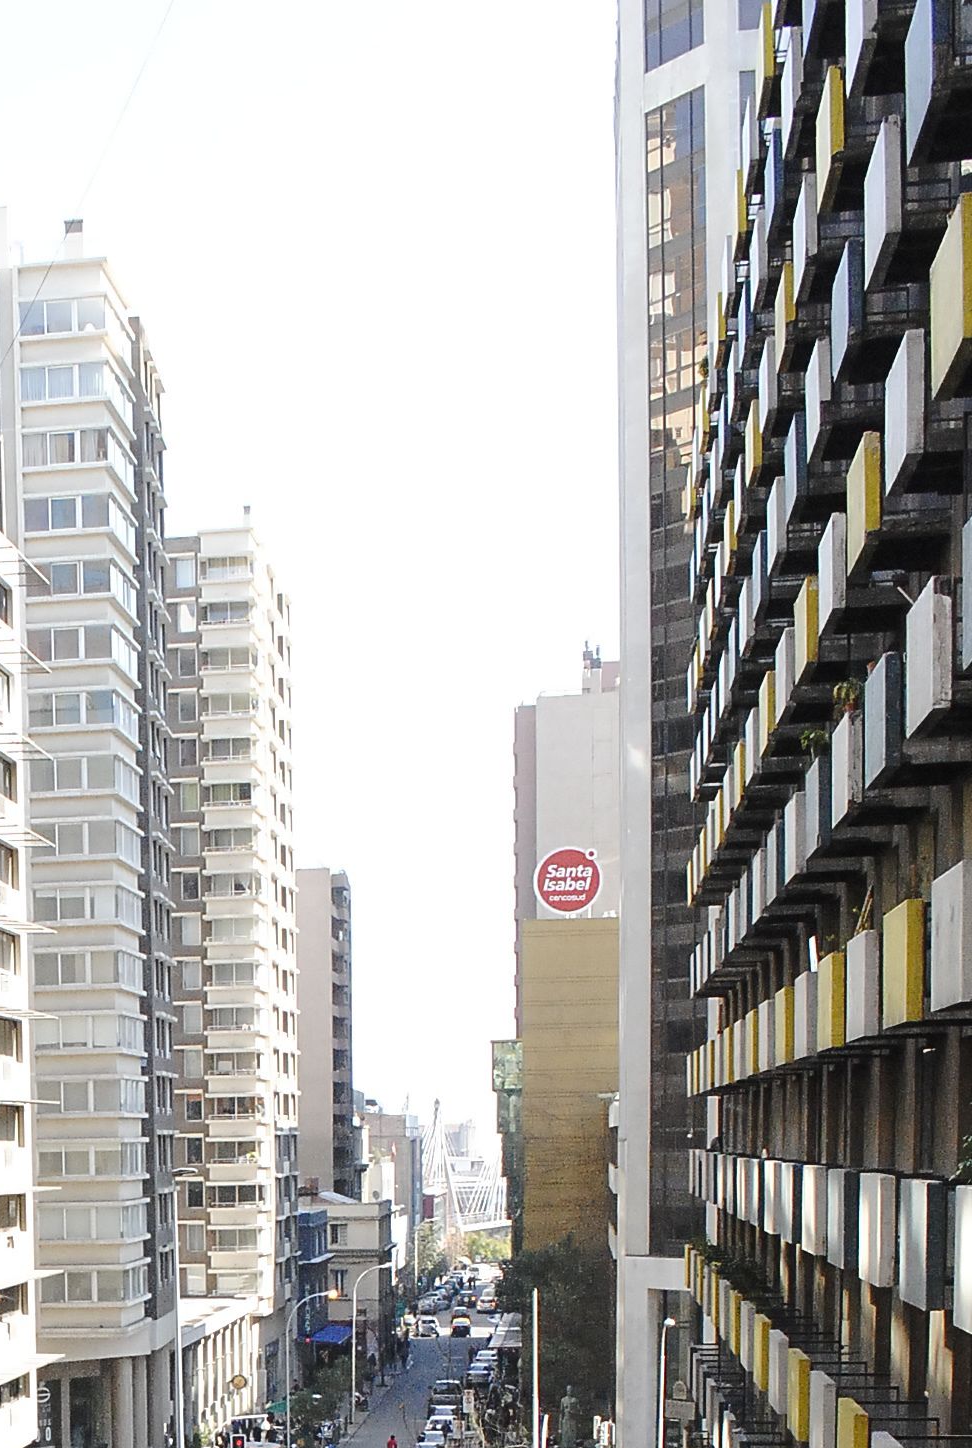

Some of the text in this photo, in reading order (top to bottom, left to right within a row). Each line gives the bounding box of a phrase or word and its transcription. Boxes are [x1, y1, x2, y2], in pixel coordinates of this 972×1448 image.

[546, 864, 593, 878] Santa
[543, 877, 591, 891] Isabel
[549, 893, 586, 902] cencosud
